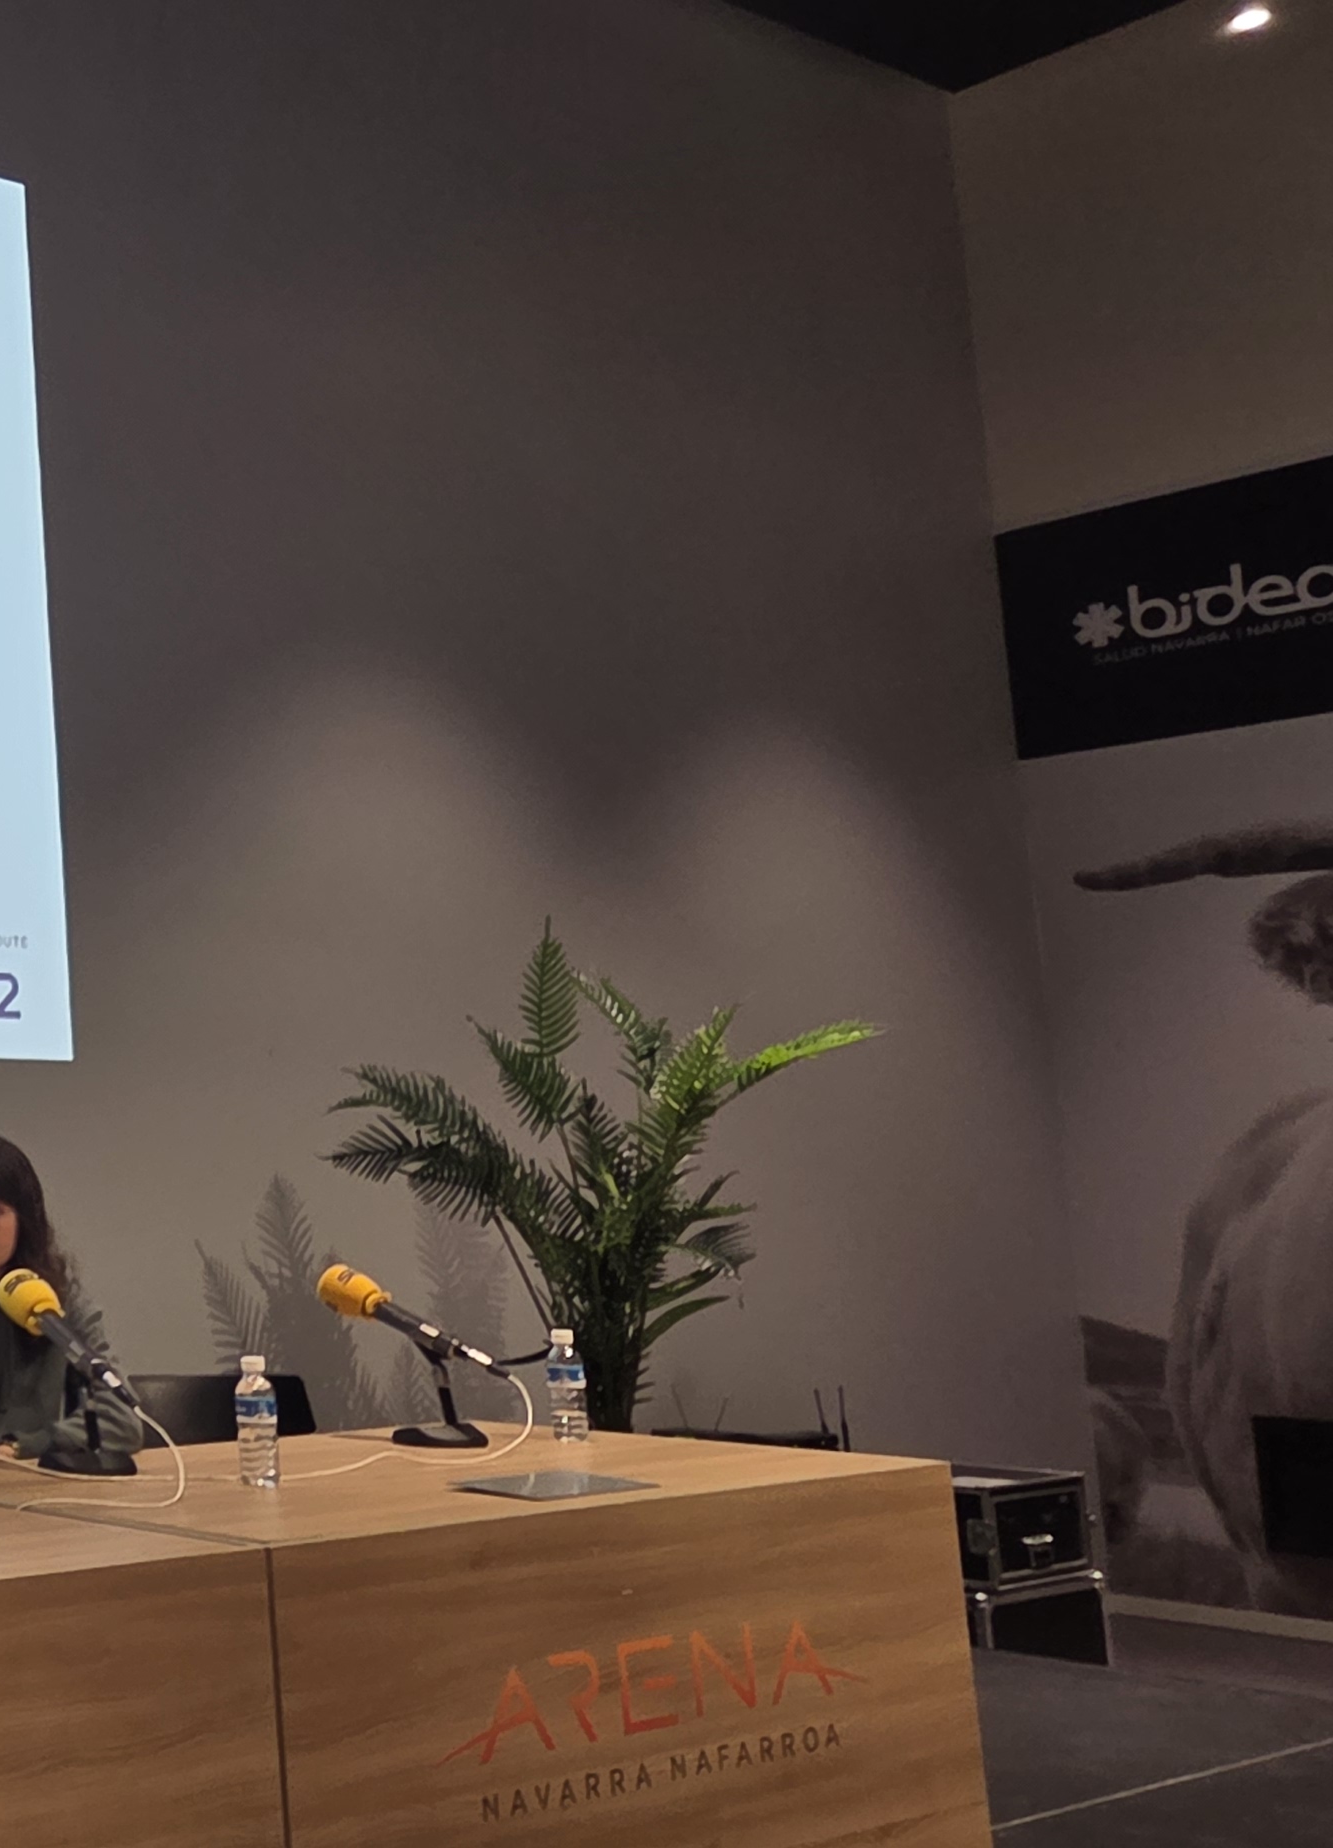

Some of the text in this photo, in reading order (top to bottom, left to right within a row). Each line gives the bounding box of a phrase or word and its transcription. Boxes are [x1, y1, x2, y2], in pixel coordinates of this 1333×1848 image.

[1150, 630, 1231, 655] NAVARRA
[1245, 615, 1306, 638] NAFAR
[433, 1620, 869, 1770] ARENA
[479, 1722, 842, 1823] NAVARRA NAFARROA
